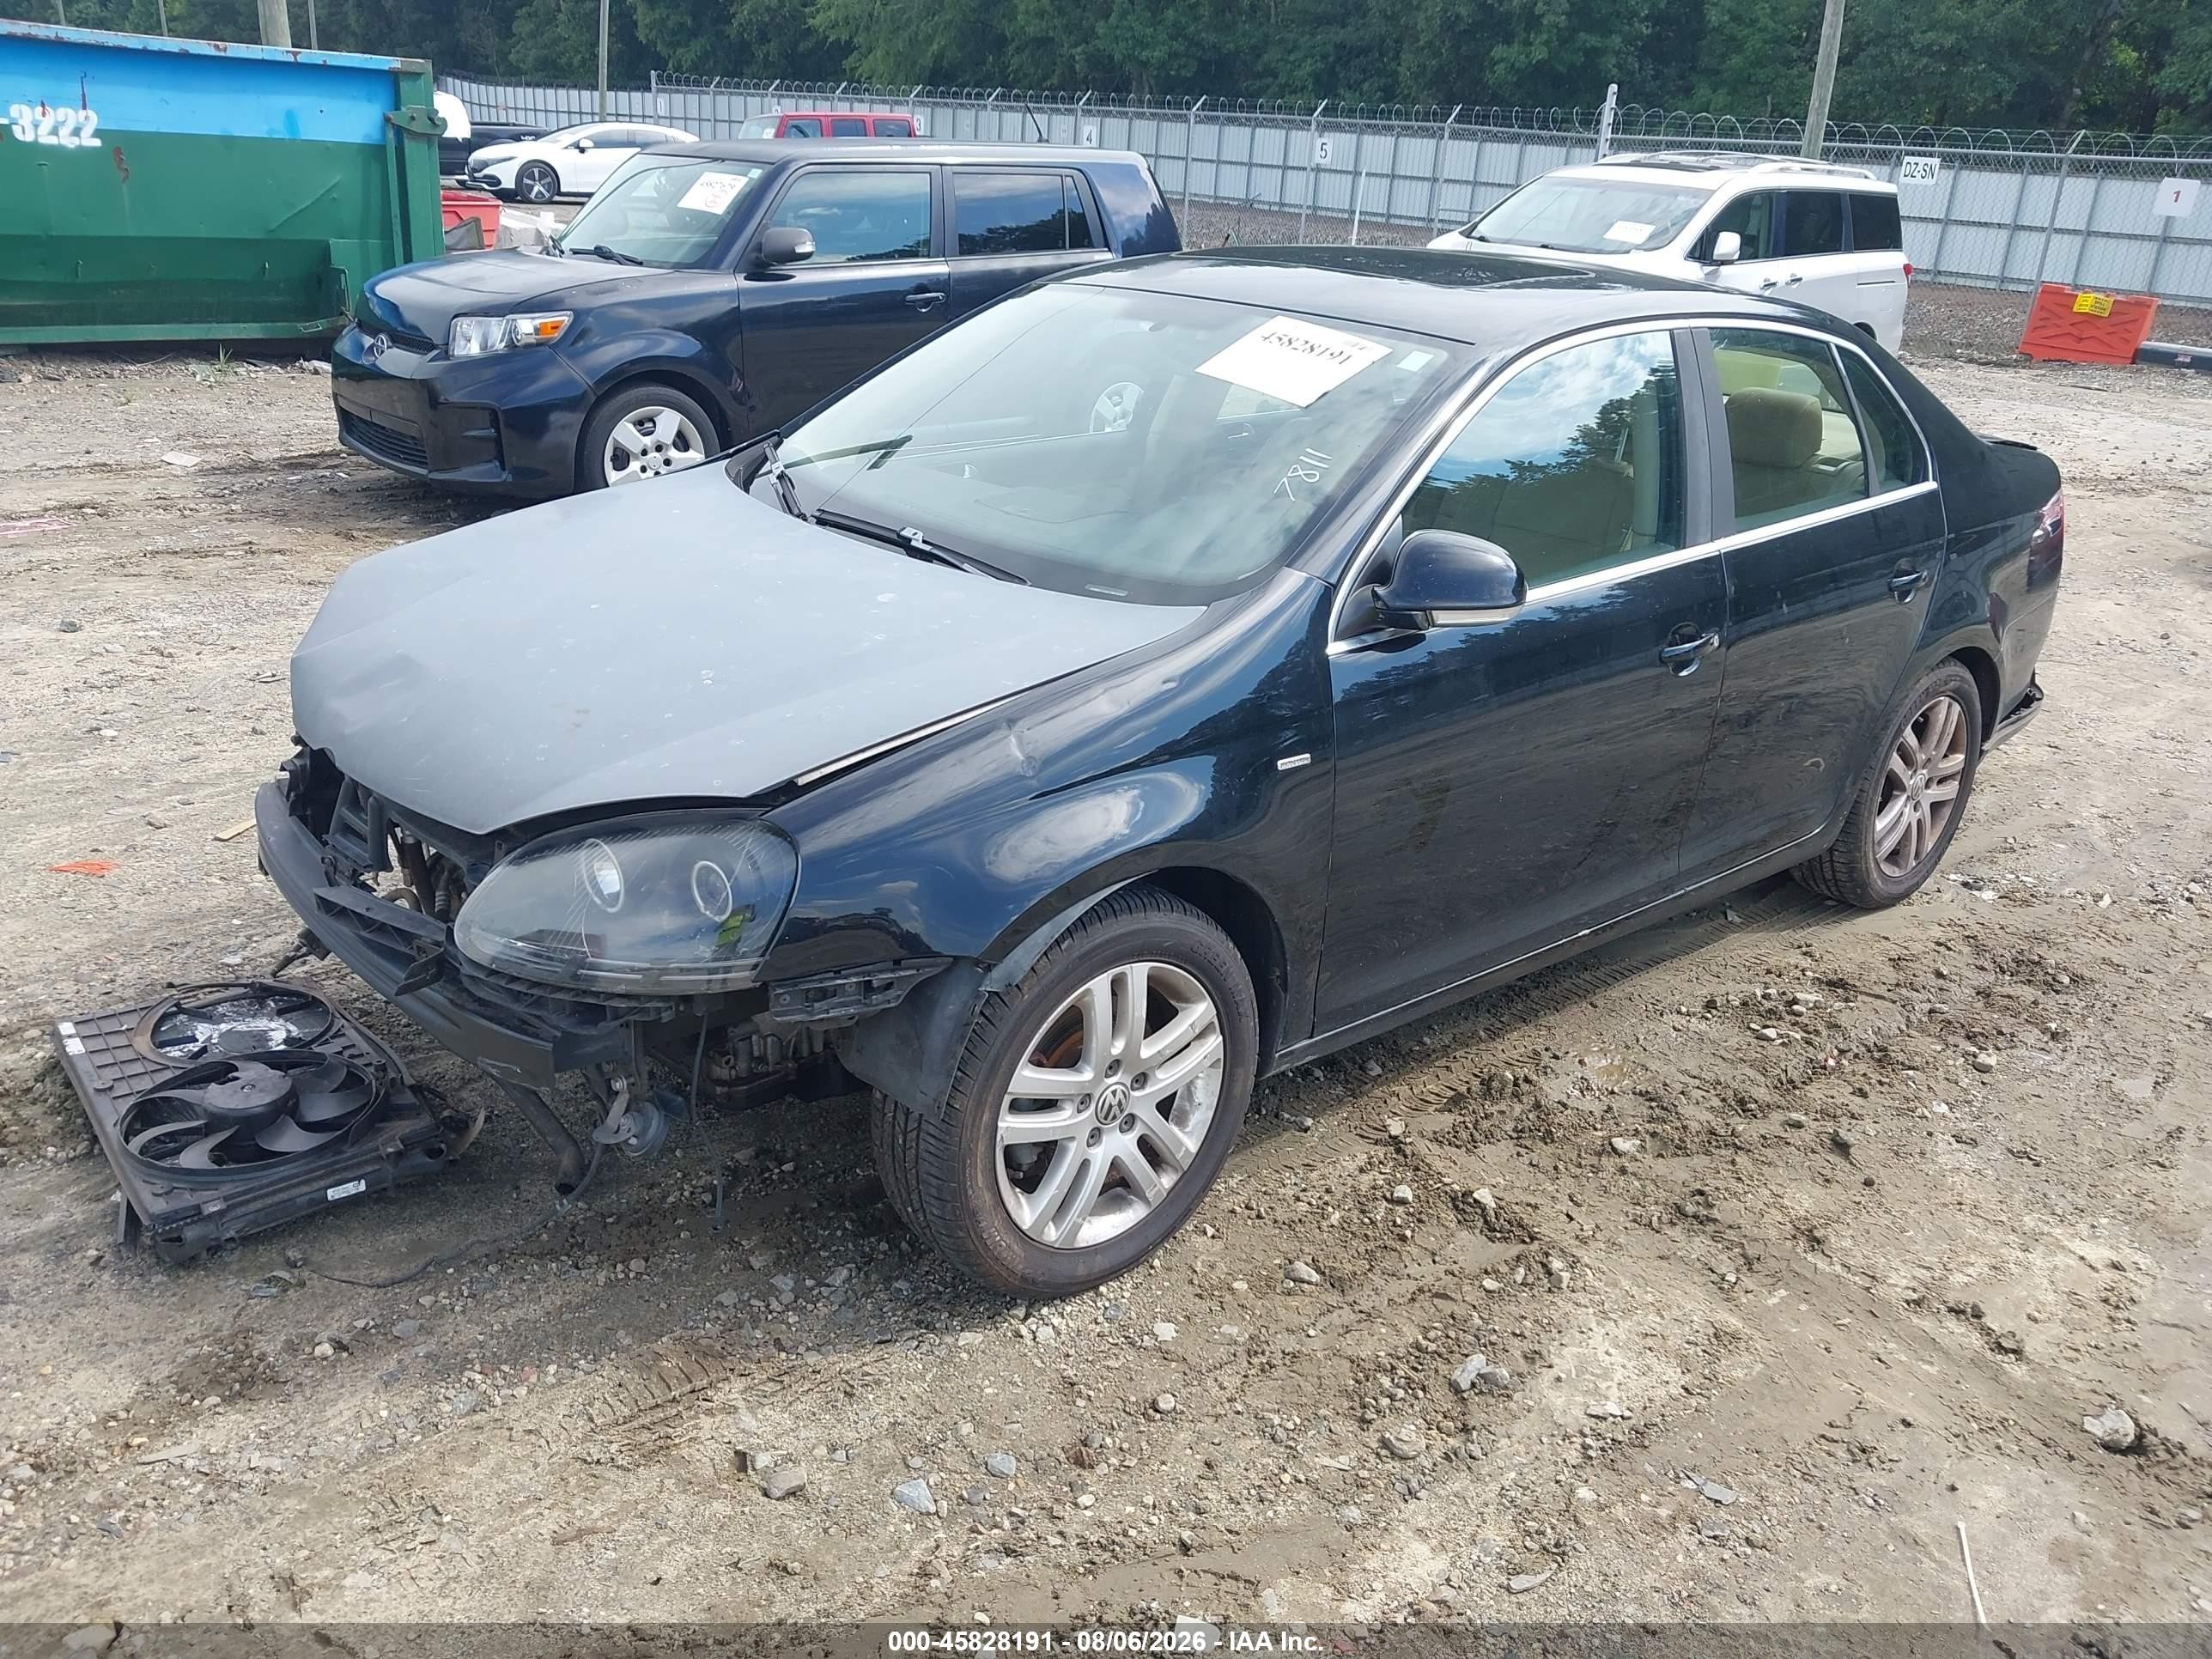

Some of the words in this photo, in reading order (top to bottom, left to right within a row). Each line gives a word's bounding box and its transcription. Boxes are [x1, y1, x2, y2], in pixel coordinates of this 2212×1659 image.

[1086, 130, 1092, 144] 4
[1320, 143, 1328, 159] 5
[1904, 161, 1937, 179] DZ-SN
[2173, 190, 2181, 203] 1
[1261, 331, 1352, 364] 45828191
[1273, 447, 1333, 501] 7811
